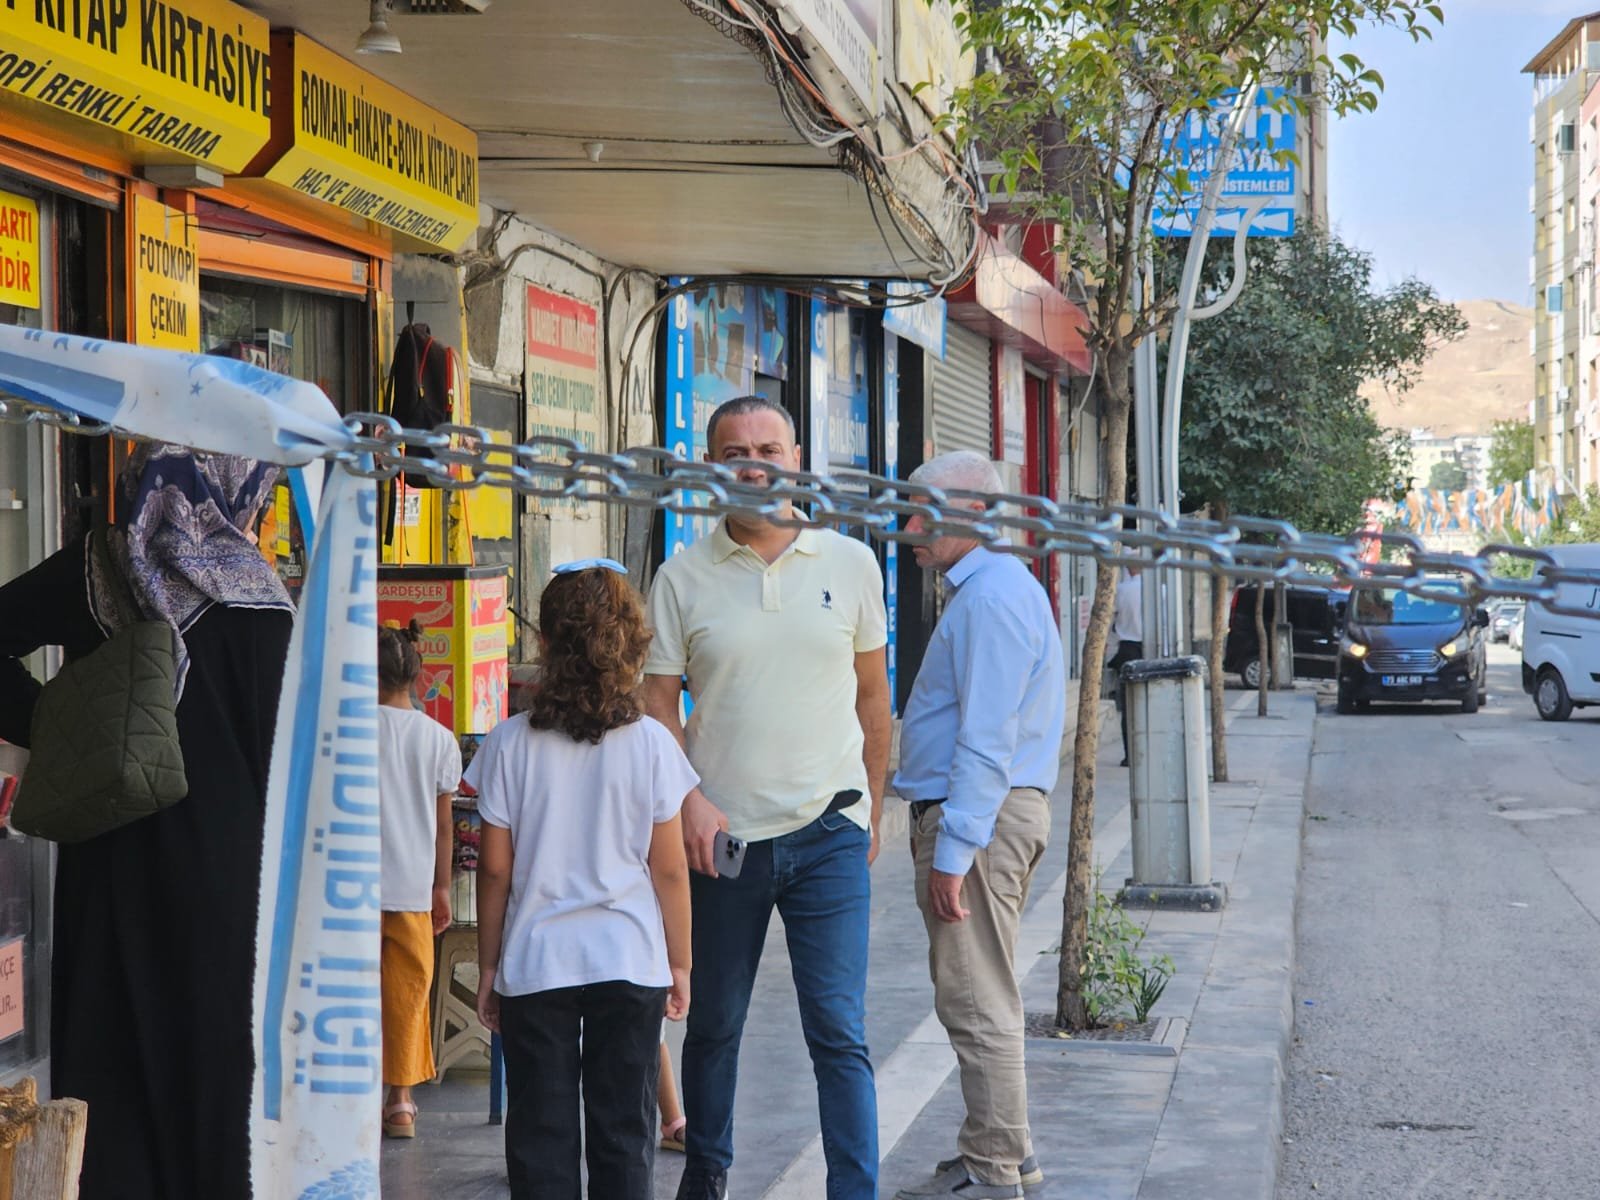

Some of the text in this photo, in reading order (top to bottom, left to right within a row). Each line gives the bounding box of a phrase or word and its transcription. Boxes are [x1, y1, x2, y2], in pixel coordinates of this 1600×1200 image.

[140, 0, 271, 118] KIRTASİYE
[0, 49, 222, 159] OPİ RENKLİ TARAMA
[292, 168, 330, 194] HAC
[325, 178, 351, 202] VE
[374, 200, 457, 245] MALZEMELERİ
[1222, 177, 1290, 193] İSTEMLERİ
[0, 206, 32, 243] ARTI
[139, 233, 196, 286] FOTOKOPİ
[150, 291, 187, 338] ÇEKİM
